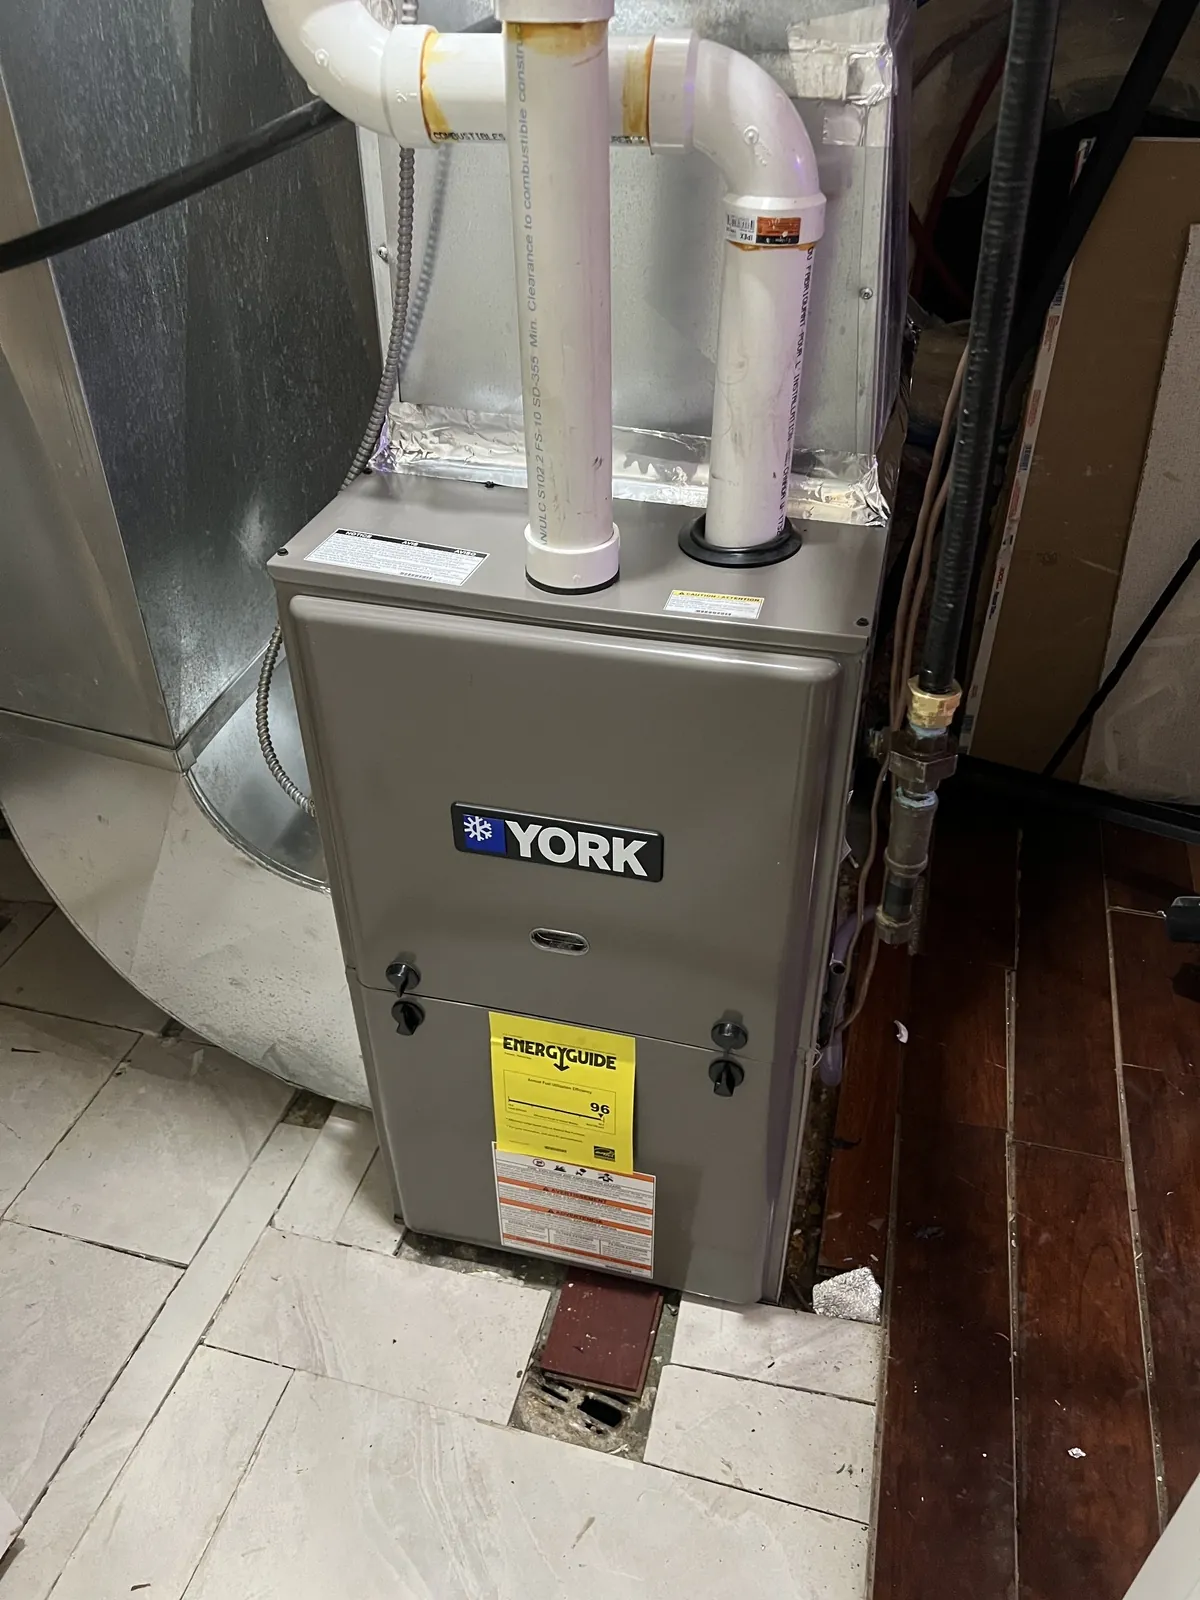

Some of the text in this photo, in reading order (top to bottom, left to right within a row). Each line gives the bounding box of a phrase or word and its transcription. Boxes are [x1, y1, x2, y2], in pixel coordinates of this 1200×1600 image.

[433, 132, 506, 142] COMBUSTIBLES
[518, 108, 532, 210] combustible
[523, 214, 533, 229] to
[525, 234, 537, 312] Clearance
[530, 356, 541, 408] SD-355
[534, 411, 544, 452] FS-10
[345, 530, 373, 539] NOTICE
[505, 820, 648, 877] YORK
[503, 1036, 617, 1071] ENERGYGUIDE
[590, 1102, 610, 1115] 96
